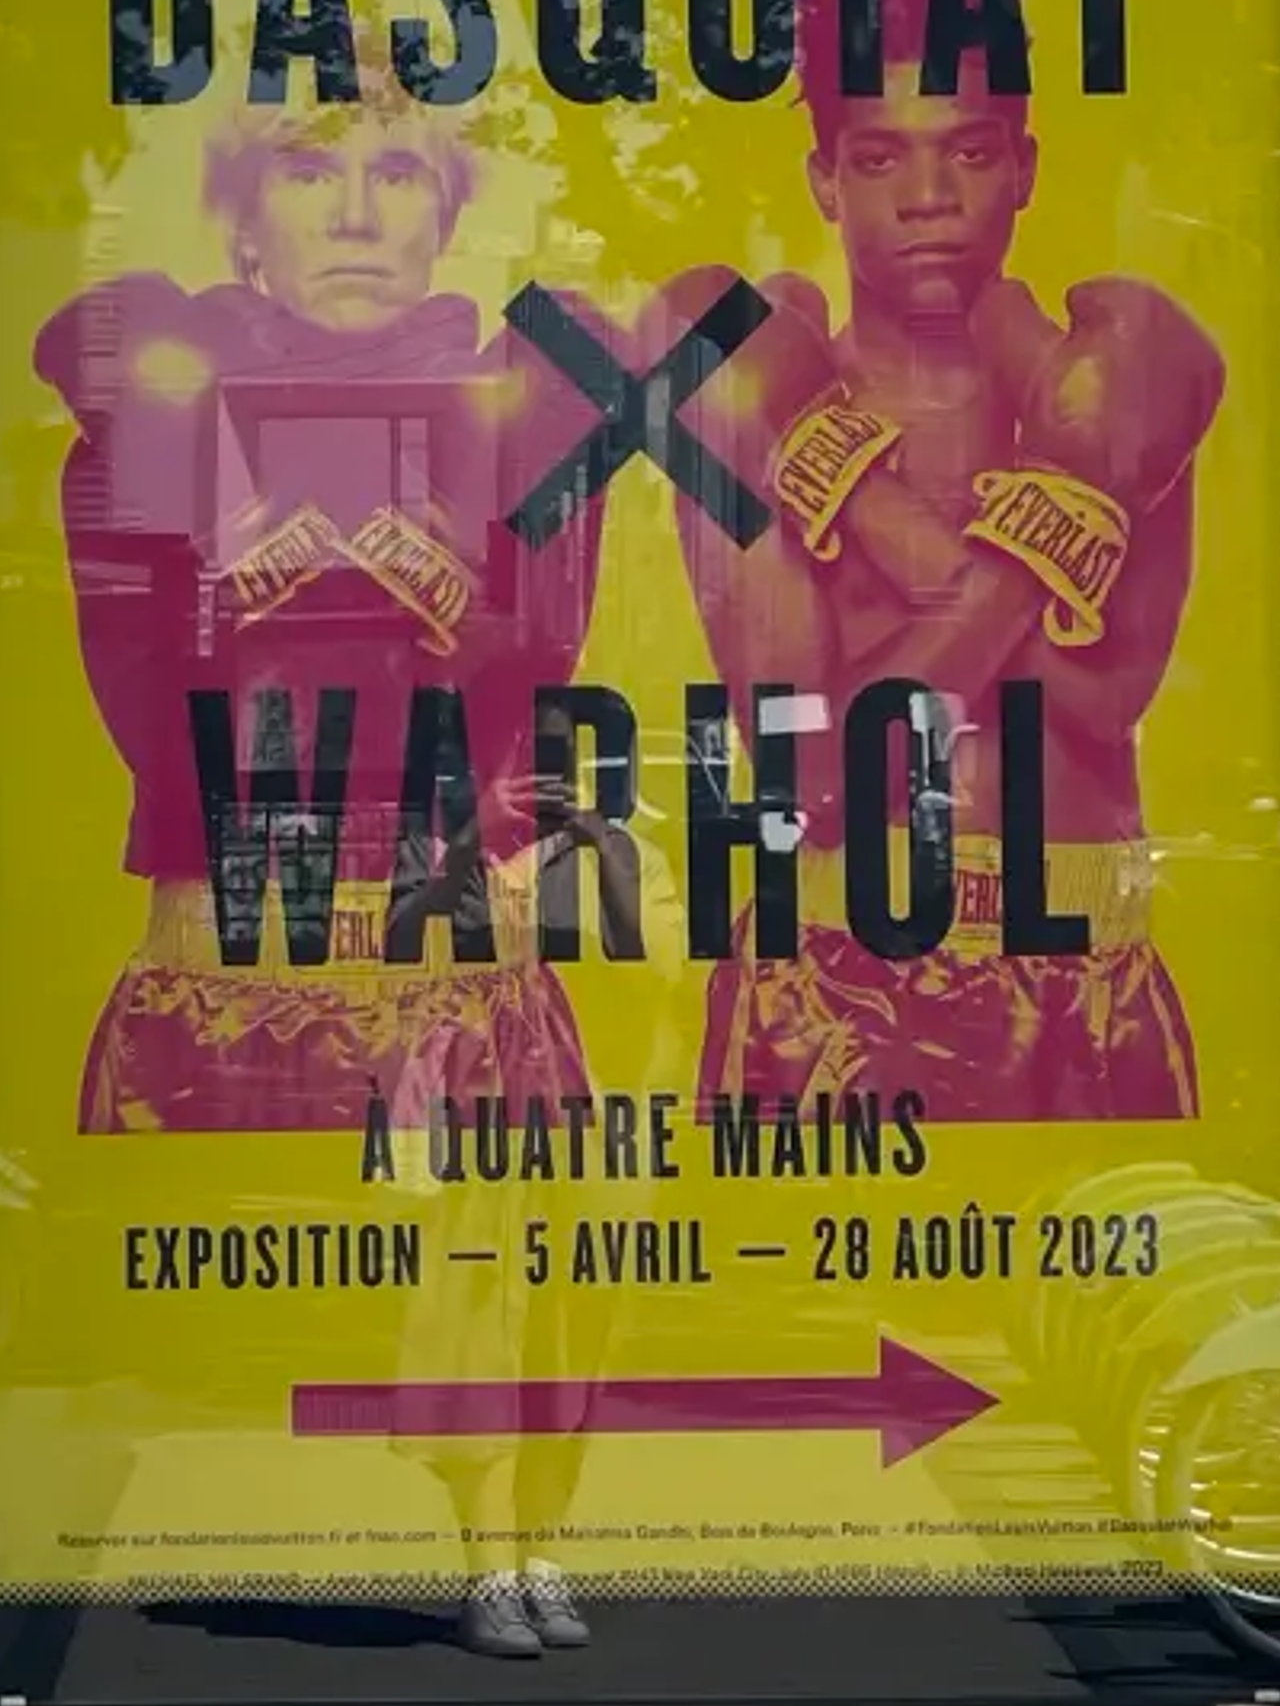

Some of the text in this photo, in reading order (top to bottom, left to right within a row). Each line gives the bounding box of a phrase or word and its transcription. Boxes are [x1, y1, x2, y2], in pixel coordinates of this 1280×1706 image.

[996, 482, 1123, 602] EVERLAST
[185, 678, 1091, 967] WARHOL
[429, 1091, 681, 1183] QUATRE
[713, 1089, 928, 1179] MAINS
[126, 1223, 422, 1292] EXPOSITION
[524, 1221, 551, 1286] 5
[572, 1218, 712, 1285] AVRIL
[813, 1215, 870, 1281] 28
[893, 1201, 1014, 1279] AOÛT
[1038, 1212, 1160, 1278] 2023
